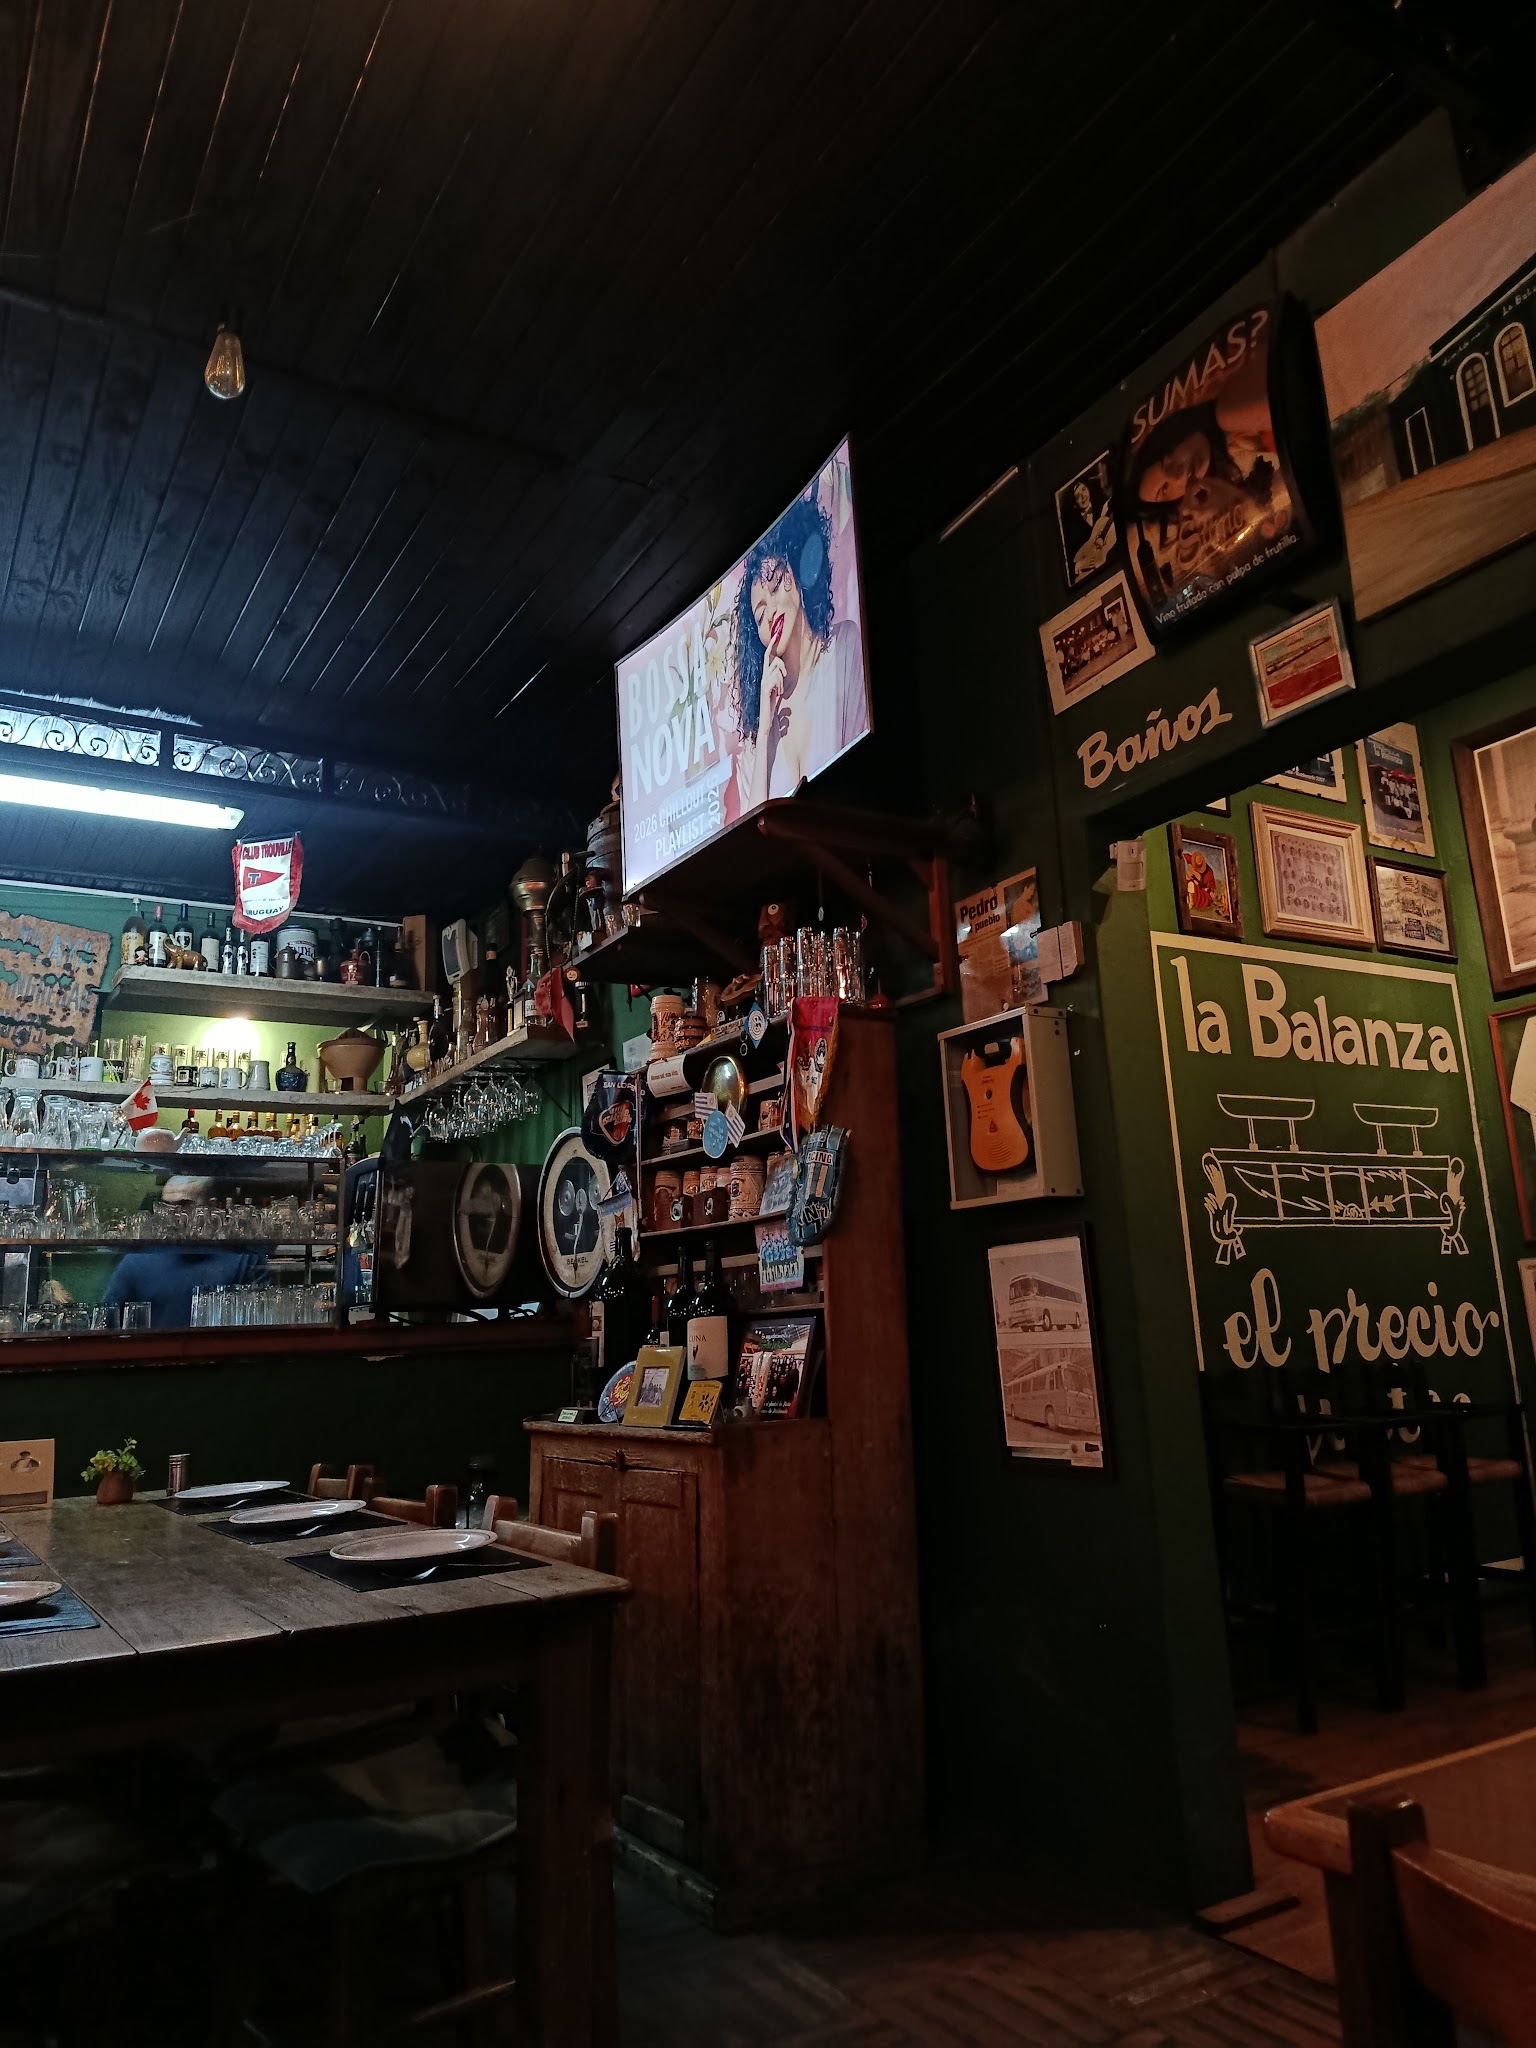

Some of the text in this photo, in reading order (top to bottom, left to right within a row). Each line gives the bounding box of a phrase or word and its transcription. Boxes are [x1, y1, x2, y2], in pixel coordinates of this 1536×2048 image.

[1130, 309, 1269, 444] SUMAS?
[1155, 608, 1176, 625] Vino
[1175, 589, 1207, 615] frutado
[1208, 578, 1225, 594] con
[1225, 562, 1252, 586] pulpa
[1252, 552, 1265, 567] de
[627, 621, 707, 738] BOSSA
[630, 693, 716, 803] NOVA
[1076, 687, 1234, 789] Baños
[633, 783, 705, 844] 2026 CHILLOUT
[655, 813, 705, 861] PLAYLIST
[242, 840, 293, 860] CLUB TROUVILLE
[248, 873, 261, 885] T
[245, 905, 284, 917] URUGUAY
[960, 894, 999, 922] Pedro
[974, 913, 1001, 934] pueblo
[1170, 955, 1460, 1074] la Balanza
[1222, 1266, 1500, 1374] el precio
